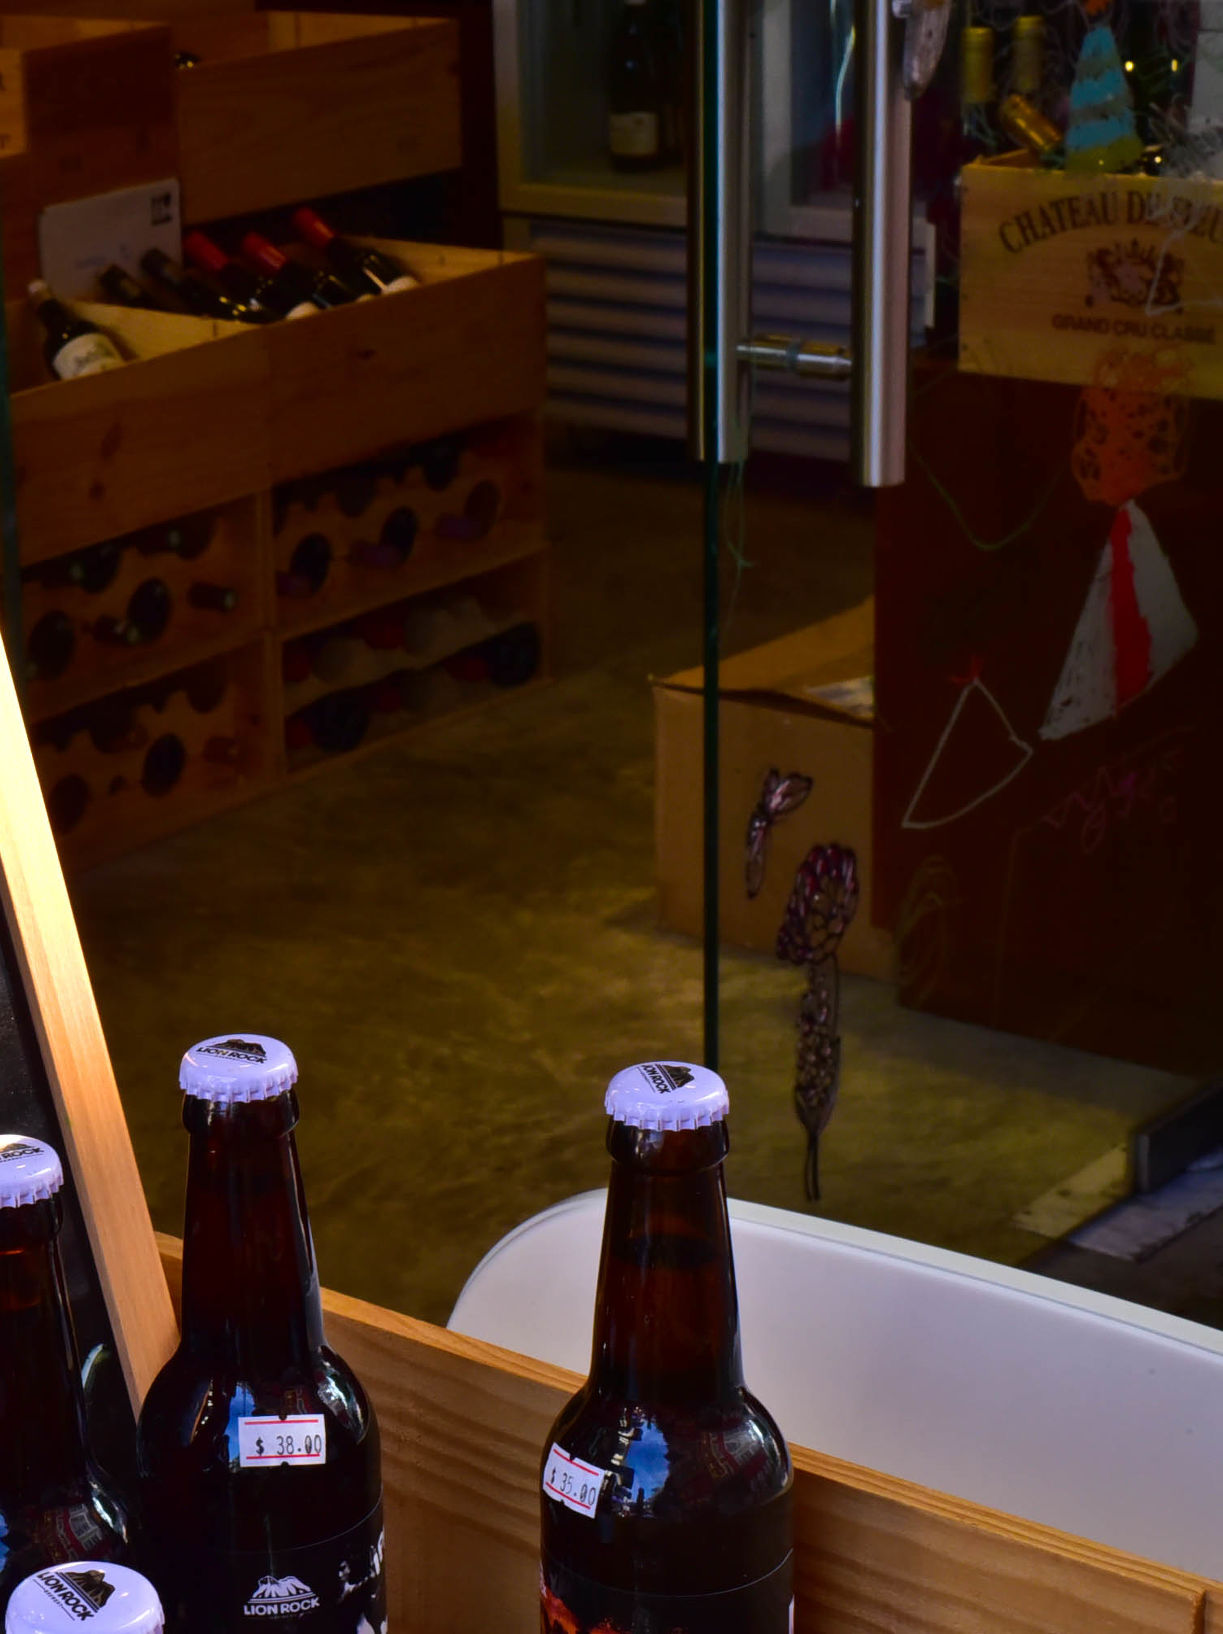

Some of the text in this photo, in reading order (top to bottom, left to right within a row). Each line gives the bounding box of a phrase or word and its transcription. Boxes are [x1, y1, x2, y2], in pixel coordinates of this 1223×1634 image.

[999, 191, 1119, 253] CHATEAU
[1051, 313, 1110, 335] GRAND
[1113, 318, 1148, 339] CRU
[196, 1046, 267, 1063] LION ROCK
[649, 1073, 671, 1094] ROCK
[1, 1147, 44, 1159] ROCK
[276, 1434, 322, 1455] 38.00
[560, 1471, 597, 1506] 35.00
[37, 1571, 68, 1594] LION
[58, 1590, 95, 1622] ROCK
[243, 1596, 321, 1616] LION ROCK
